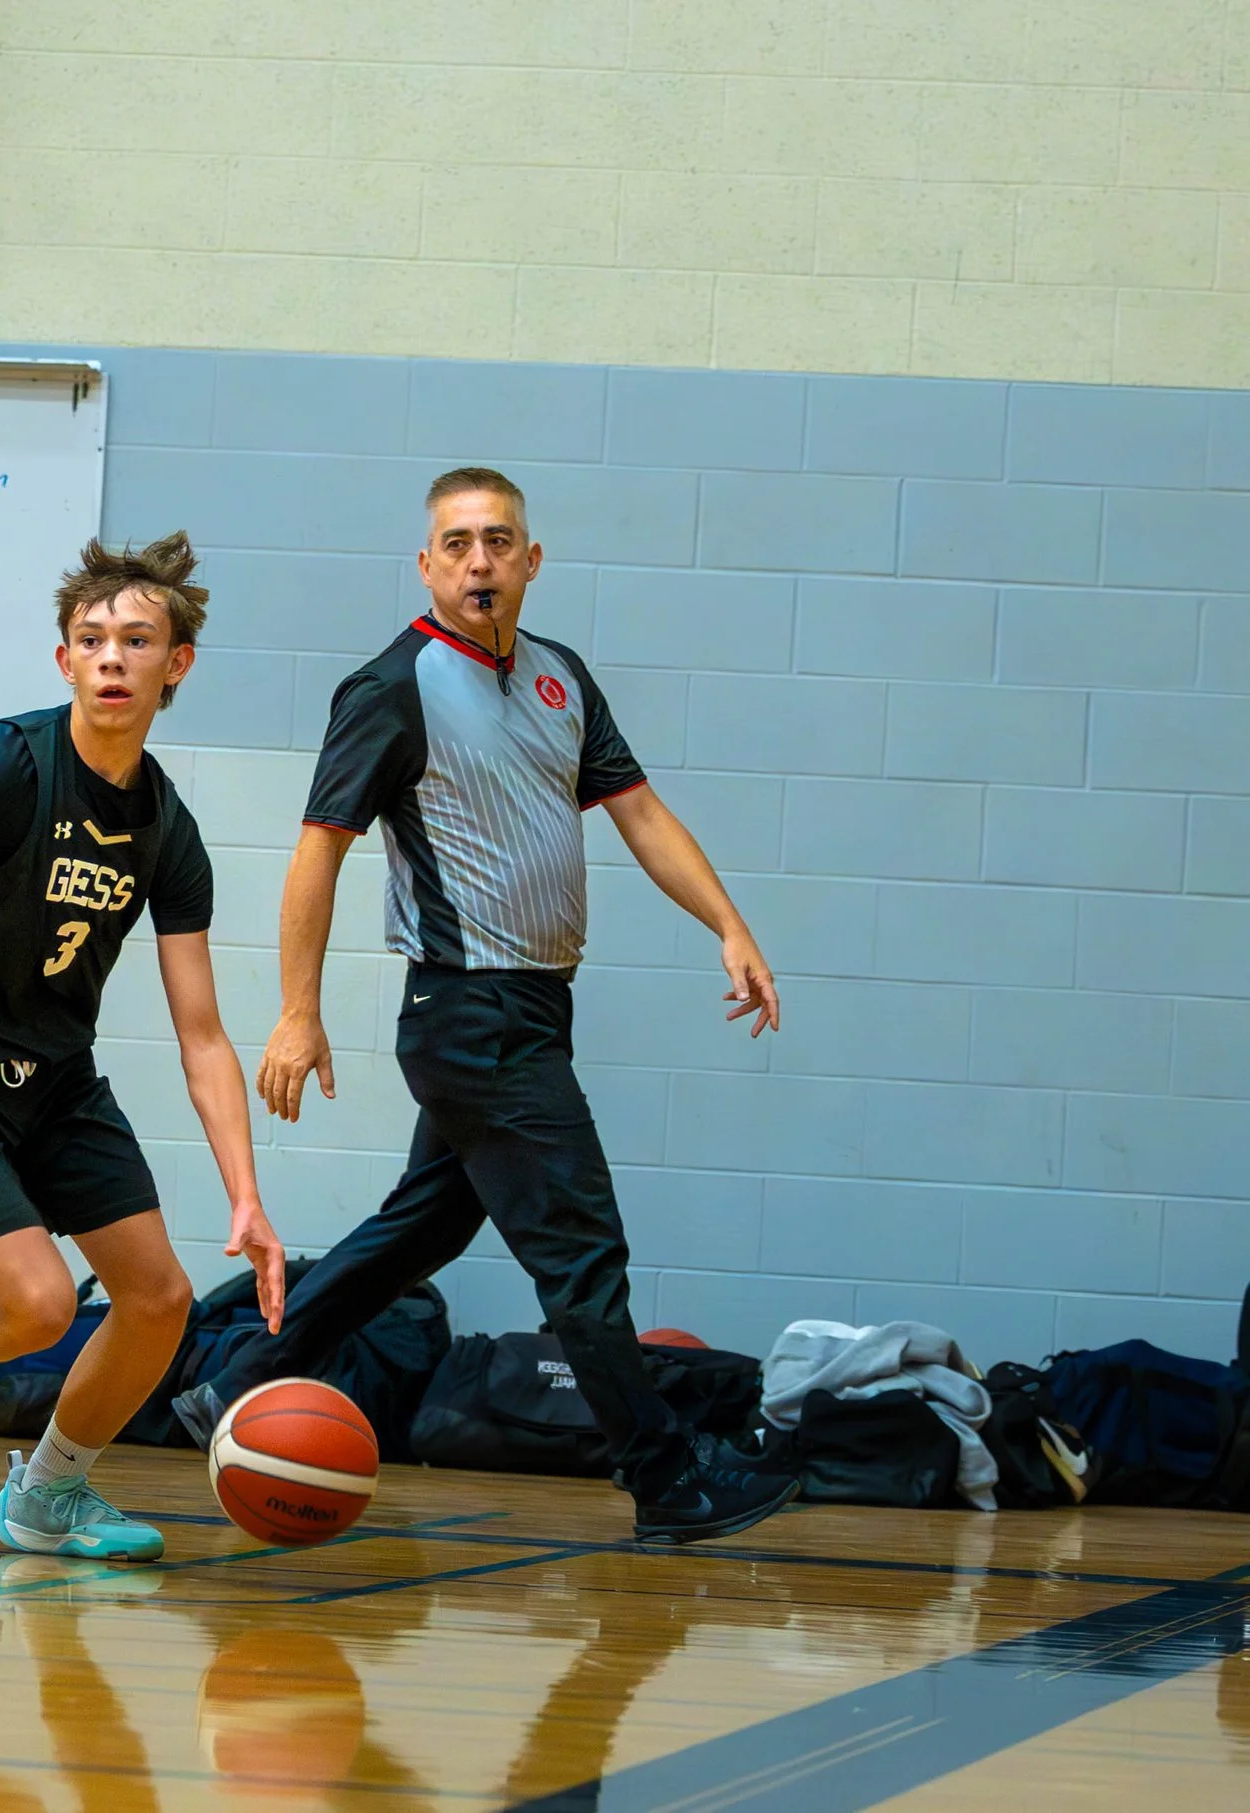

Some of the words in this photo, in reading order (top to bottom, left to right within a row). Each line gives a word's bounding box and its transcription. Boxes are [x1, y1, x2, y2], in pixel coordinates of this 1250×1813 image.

[46, 856, 135, 912] GESS
[42, 920, 91, 977] 3
[266, 1496, 339, 1522] molten
